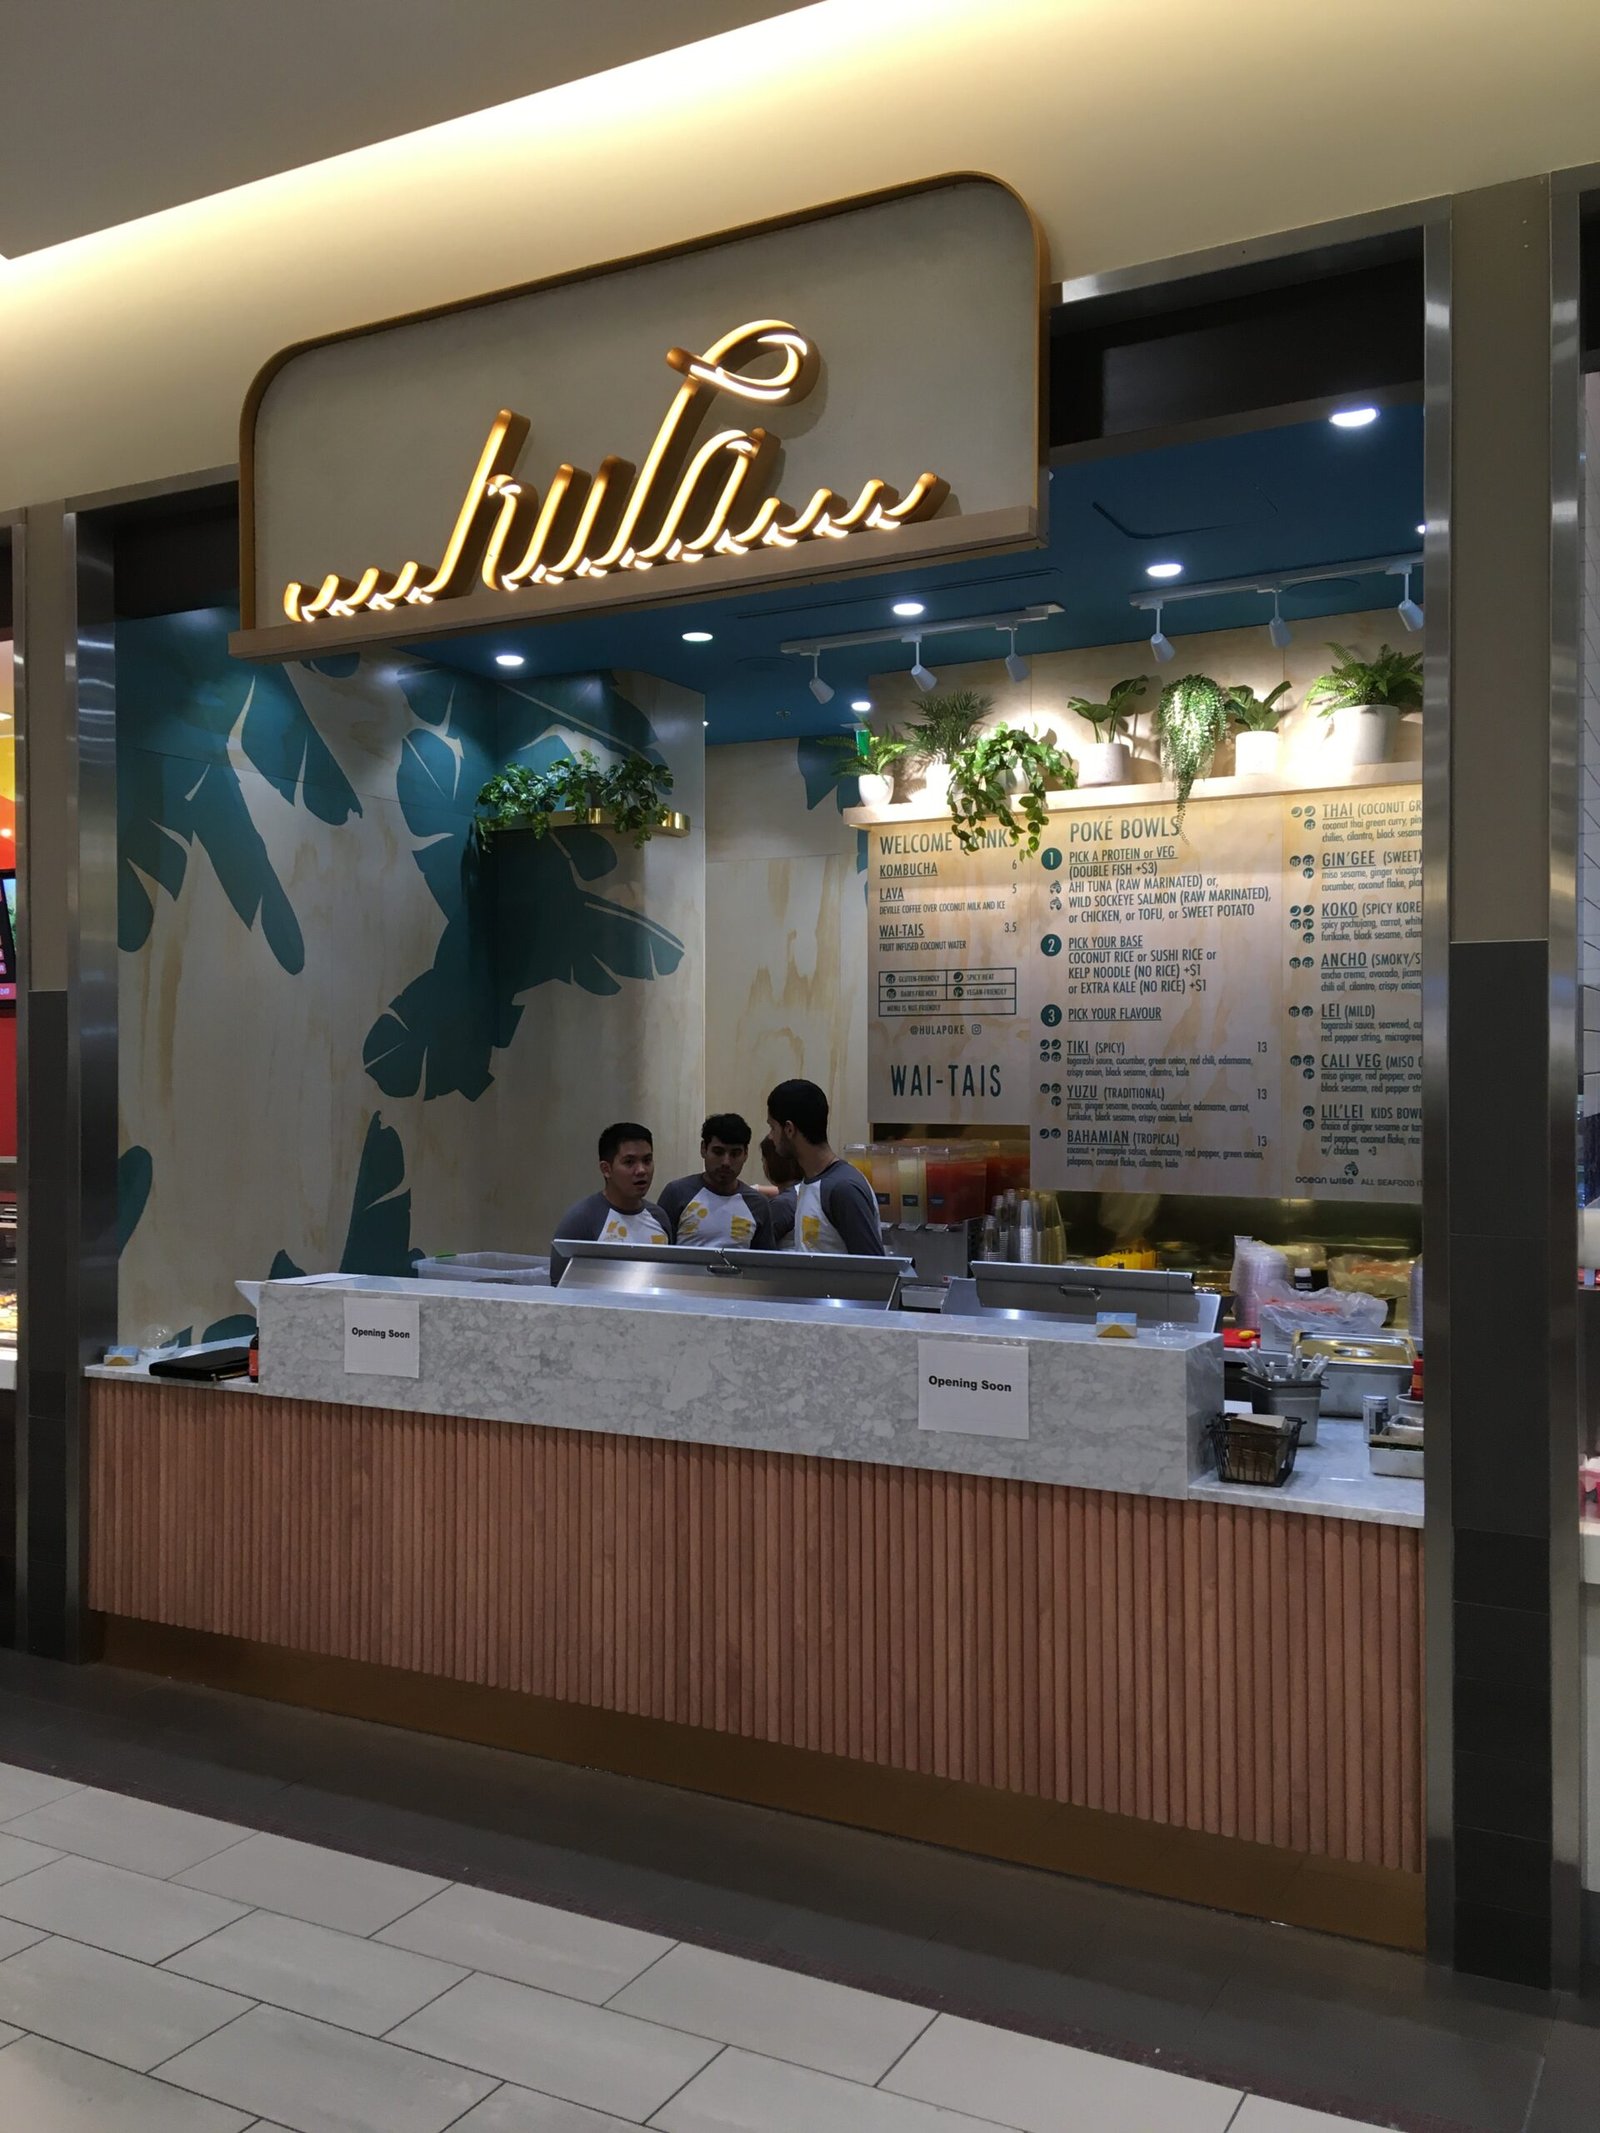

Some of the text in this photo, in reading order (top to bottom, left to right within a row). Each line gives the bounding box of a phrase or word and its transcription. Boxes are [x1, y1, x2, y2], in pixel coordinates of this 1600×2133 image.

[1322, 802, 1353, 817] THAI
[1358, 801, 1404, 818] (COCONUT
[1070, 816, 1180, 842] POKÉ BOWLS
[880, 833, 952, 856] WELCOME
[1069, 846, 1174, 863] PICK A PROTEIN or VEG
[880, 860, 1017, 877] KOMBUCHA 6
[1069, 865, 1108, 880] (DOUBLE
[1112, 863, 1132, 875] FISH
[1069, 881, 1084, 893] AHI
[1088, 879, 1112, 892] TUNA
[1115, 878, 1139, 893] (RAW
[1144, 874, 1203, 890] MARINATED)
[880, 884, 1017, 901] LAVA 5
[1069, 896, 1091, 908] WILD
[1095, 894, 1134, 907] SOCKEYE
[1137, 893, 1176, 906] SALMON
[1180, 890, 1205, 905] (RAW
[902, 904, 921, 914] COFFEE
[923, 904, 937, 913] OVER
[939, 902, 965, 912] COCONUT
[967, 901, 981, 910] MILK
[983, 901, 994, 910] AND
[997, 900, 1005, 909] ICE
[1069, 904, 1255, 924] or CHICKEN, or TOFU, or SWEET POTATO
[1322, 902, 1357, 916] KOKO
[1362, 902, 1392, 918] (SPICY
[880, 922, 1017, 937] WAI-TAIS 3.5
[1068, 935, 1143, 949] PICK YOUR BASE
[1068, 949, 1217, 964] COCONUT RICE or SUSHI RICE or
[1321, 952, 1366, 966] ANCHO
[1068, 967, 1090, 979] KELP
[1093, 966, 1130, 978] NOODLE
[1134, 964, 1152, 979] (NO
[1156, 963, 1180, 978] RICE)
[1068, 984, 1077, 994] or
[1080, 981, 1109, 993] EXTRA
[1113, 980, 1136, 993] KALE
[1139, 980, 1158, 995] (NO
[1161, 979, 1185, 994] RICE)
[1068, 1007, 1161, 1020] PICK YOUR FLAVOUR
[1322, 1003, 1375, 1019] LEI (MILD)
[1067, 1041, 1267, 1055] TIKI (SPICY) 13
[1322, 1053, 1414, 1070] CALI VEG (MISO
[891, 1064, 1002, 1097] WAI-TAIS
[1067, 1085, 1267, 1101] YUZU (TRADITIONAL) 13
[1370, 1107, 1393, 1119] KIDS
[1067, 1130, 1267, 1147] BAHAMIAN (TROPICAL) 13
[352, 1327, 410, 1339] Opening Soon
[929, 1375, 1011, 1391] Opening Soon
